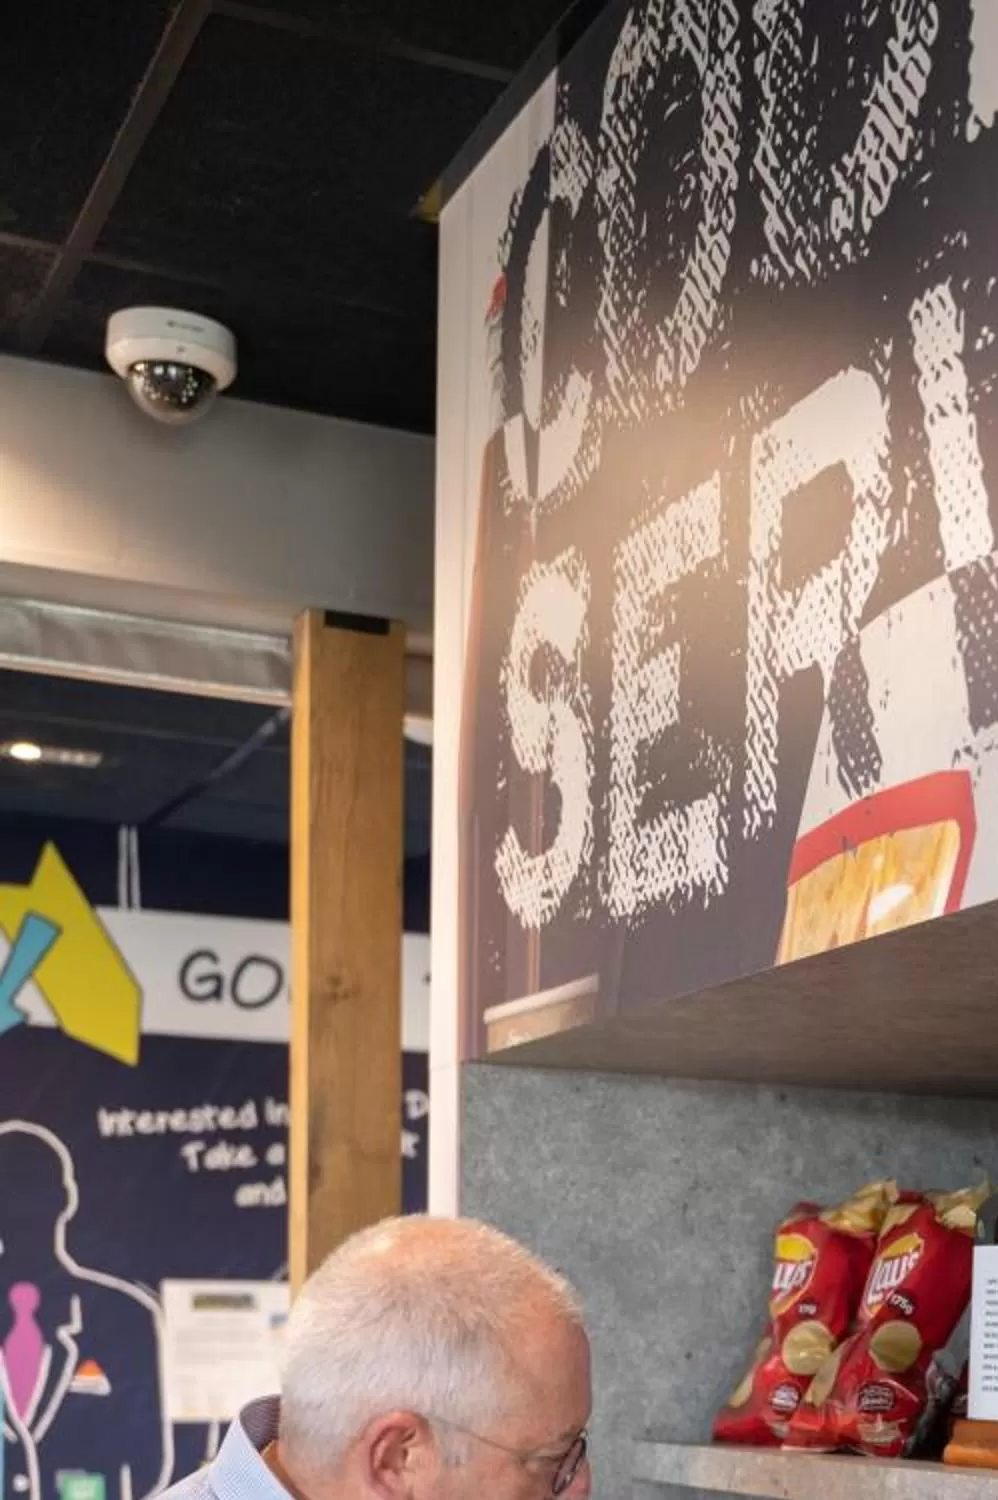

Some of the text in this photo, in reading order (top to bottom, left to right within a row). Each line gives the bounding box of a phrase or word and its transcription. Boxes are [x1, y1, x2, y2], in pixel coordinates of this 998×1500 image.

[178, 948, 285, 1011] GO
[97, 1101, 259, 1137] Interested
[180, 1140, 257, 1173] Take
[234, 1175, 288, 1208] and
